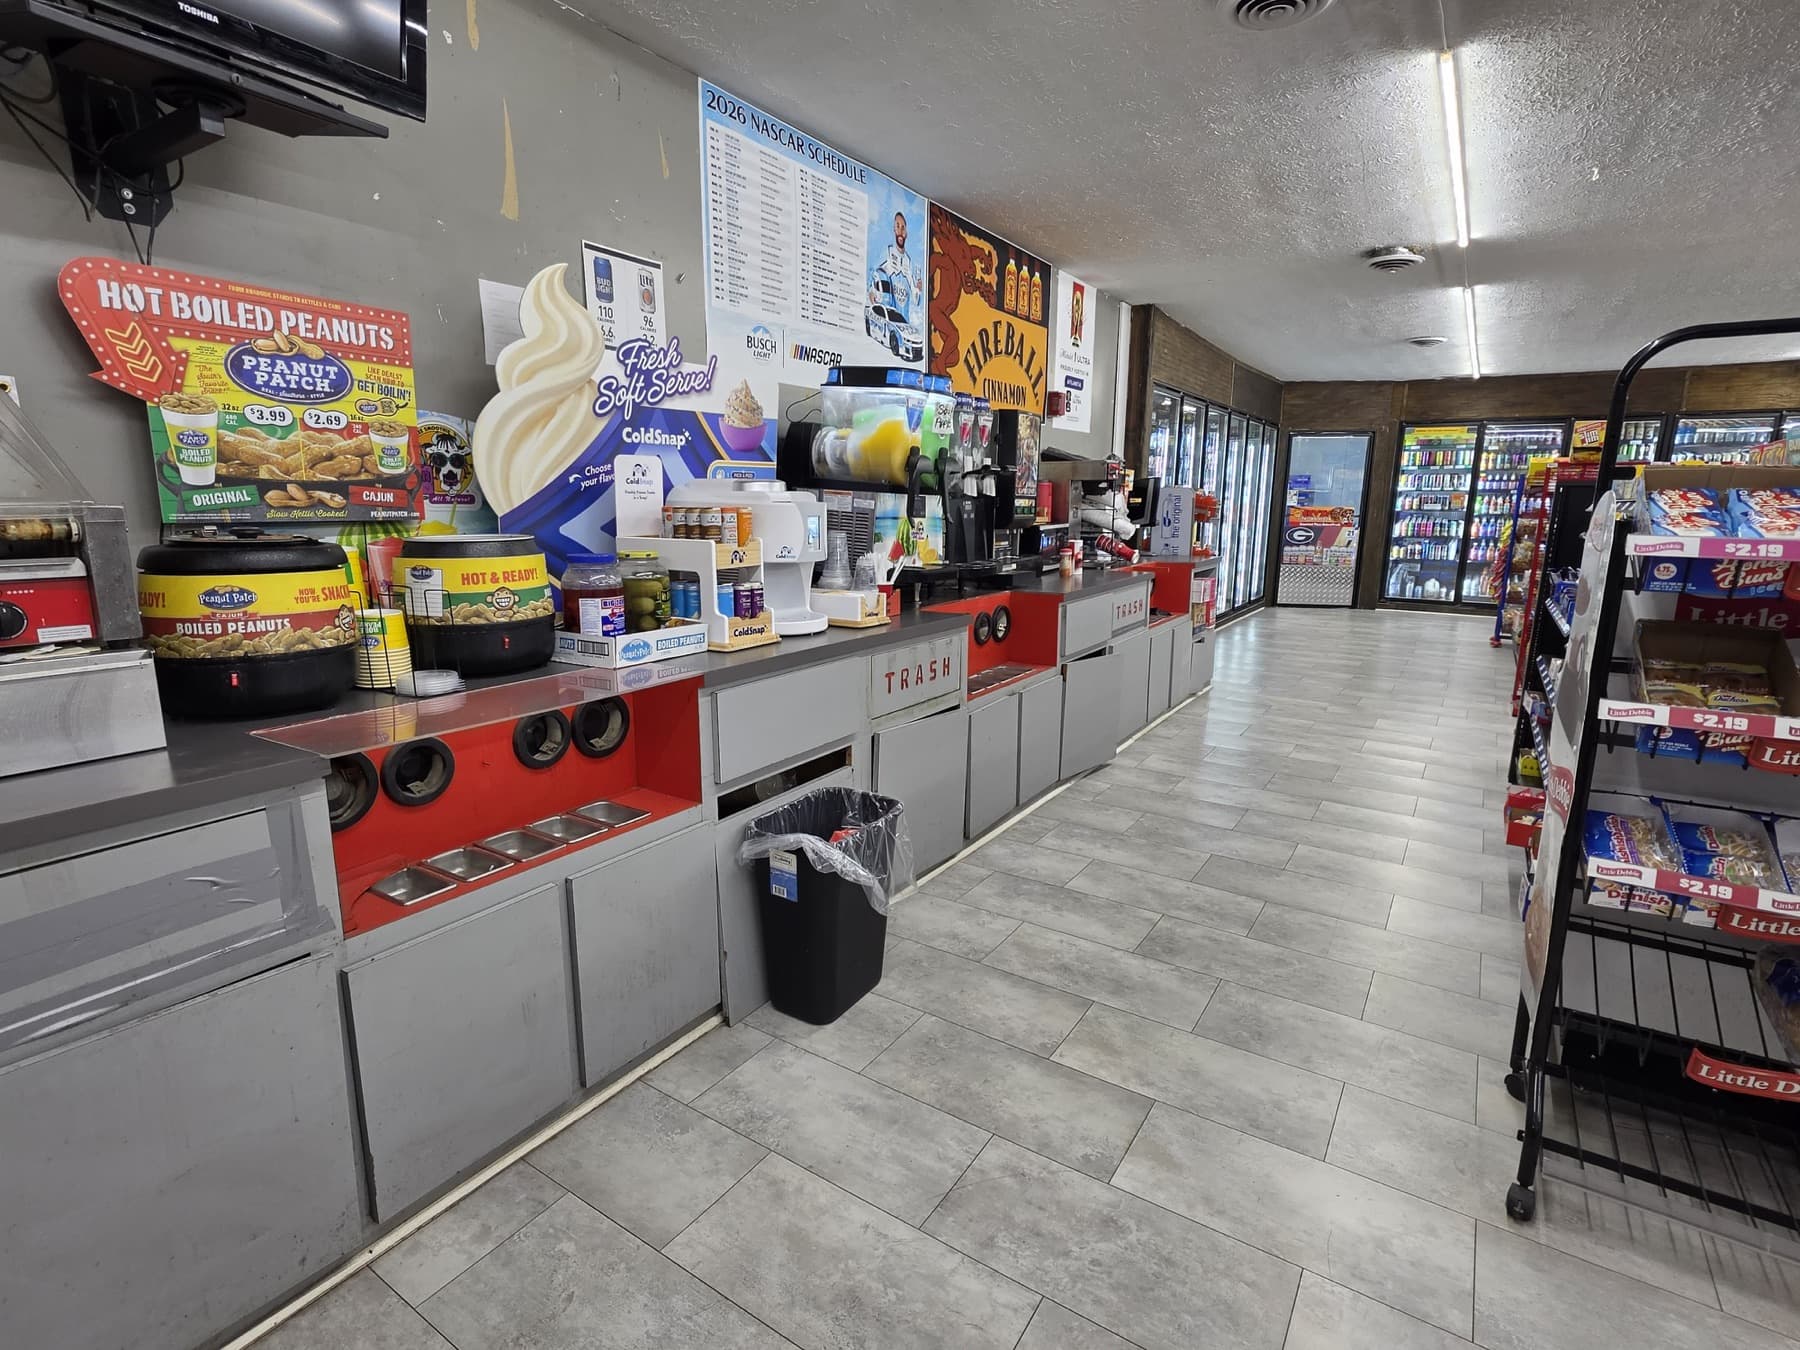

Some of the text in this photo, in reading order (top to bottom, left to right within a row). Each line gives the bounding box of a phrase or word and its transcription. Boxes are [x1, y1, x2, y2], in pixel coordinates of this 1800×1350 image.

[178, 1, 219, 24] TOSHIBA
[706, 89, 867, 185] 2026 NASCAR SCHEDULE
[97, 279, 394, 351] HOT BOILED PEANUTS
[598, 305, 614, 319] 110
[643, 315, 654, 328] 96
[746, 335, 777, 354] BUSCH
[618, 337, 681, 376] Fresh
[753, 350, 771, 360] LIGHT
[803, 347, 843, 367] NASCAR
[963, 320, 1044, 399] FIREBALL
[241, 355, 339, 380] PEANUT
[367, 365, 402, 380] LIKE DEALS?
[253, 371, 331, 393] PATCH
[366, 373, 381, 382] SCAN
[358, 380, 375, 393] GET
[593, 355, 718, 421] Soft Serve!
[982, 378, 1027, 408] CINNAMON
[250, 408, 286, 422] $3.99
[309, 412, 342, 426] $2.69
[622, 427, 686, 449] ColdSnap
[585, 463, 612, 476] Choose
[580, 477, 598, 491] your
[192, 490, 252, 507] ORIGINAL
[363, 491, 394, 503] CAJUN
[1725, 543, 1784, 558] $2.19
[461, 568, 538, 586] HOT & READY!
[200, 592, 258, 604] Peanut Patch
[294, 595, 320, 604] YOU'RE
[1116, 600, 1144, 620] TRASH
[1690, 607, 1789, 629] Little
[176, 618, 291, 635] BOILED PEANUTS
[733, 626, 766, 638] ColdSnap
[657, 634, 704, 650] BOILED PEANUTS
[885, 657, 950, 695] TRASH
[1628, 708, 1654, 717] Debbie
[1693, 713, 1749, 731] $2.19
[1705, 731, 1754, 748] Bun
[1598, 867, 1641, 878] Little Debbie
[1679, 878, 1733, 899] $2.19
[1608, 890, 1670, 906] Danish
[1729, 912, 1800, 936] Little
[1697, 1063, 1769, 1090] Little
